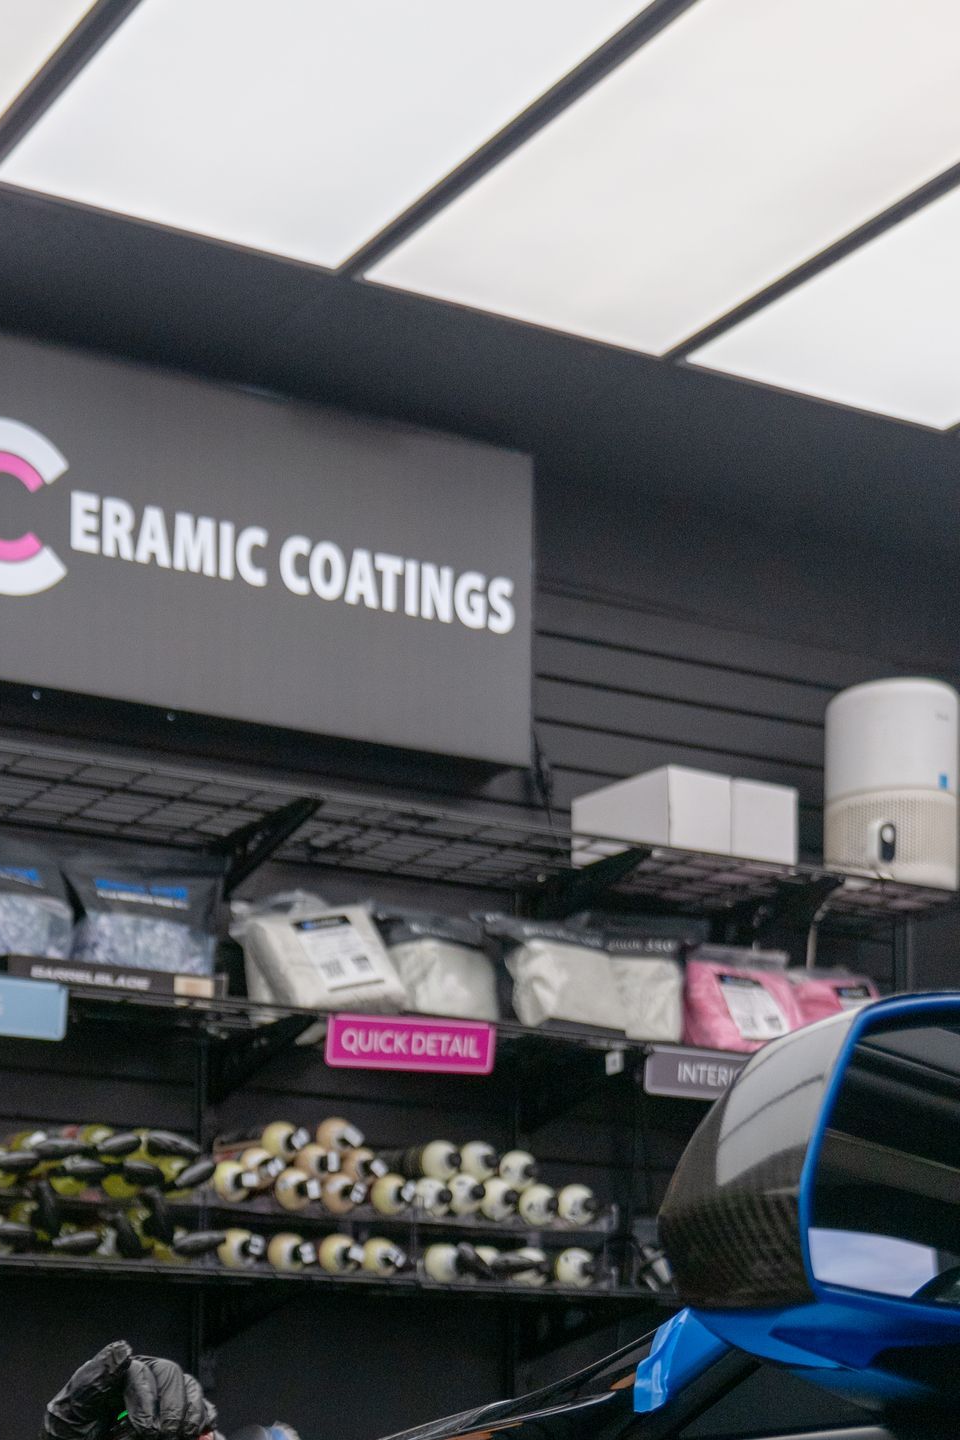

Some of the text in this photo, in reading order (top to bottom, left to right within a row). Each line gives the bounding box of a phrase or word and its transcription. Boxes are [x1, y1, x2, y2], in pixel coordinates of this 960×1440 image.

[279, 535, 515, 635] COATINGS
[341, 1028, 480, 1059] QUICK DETAIL
